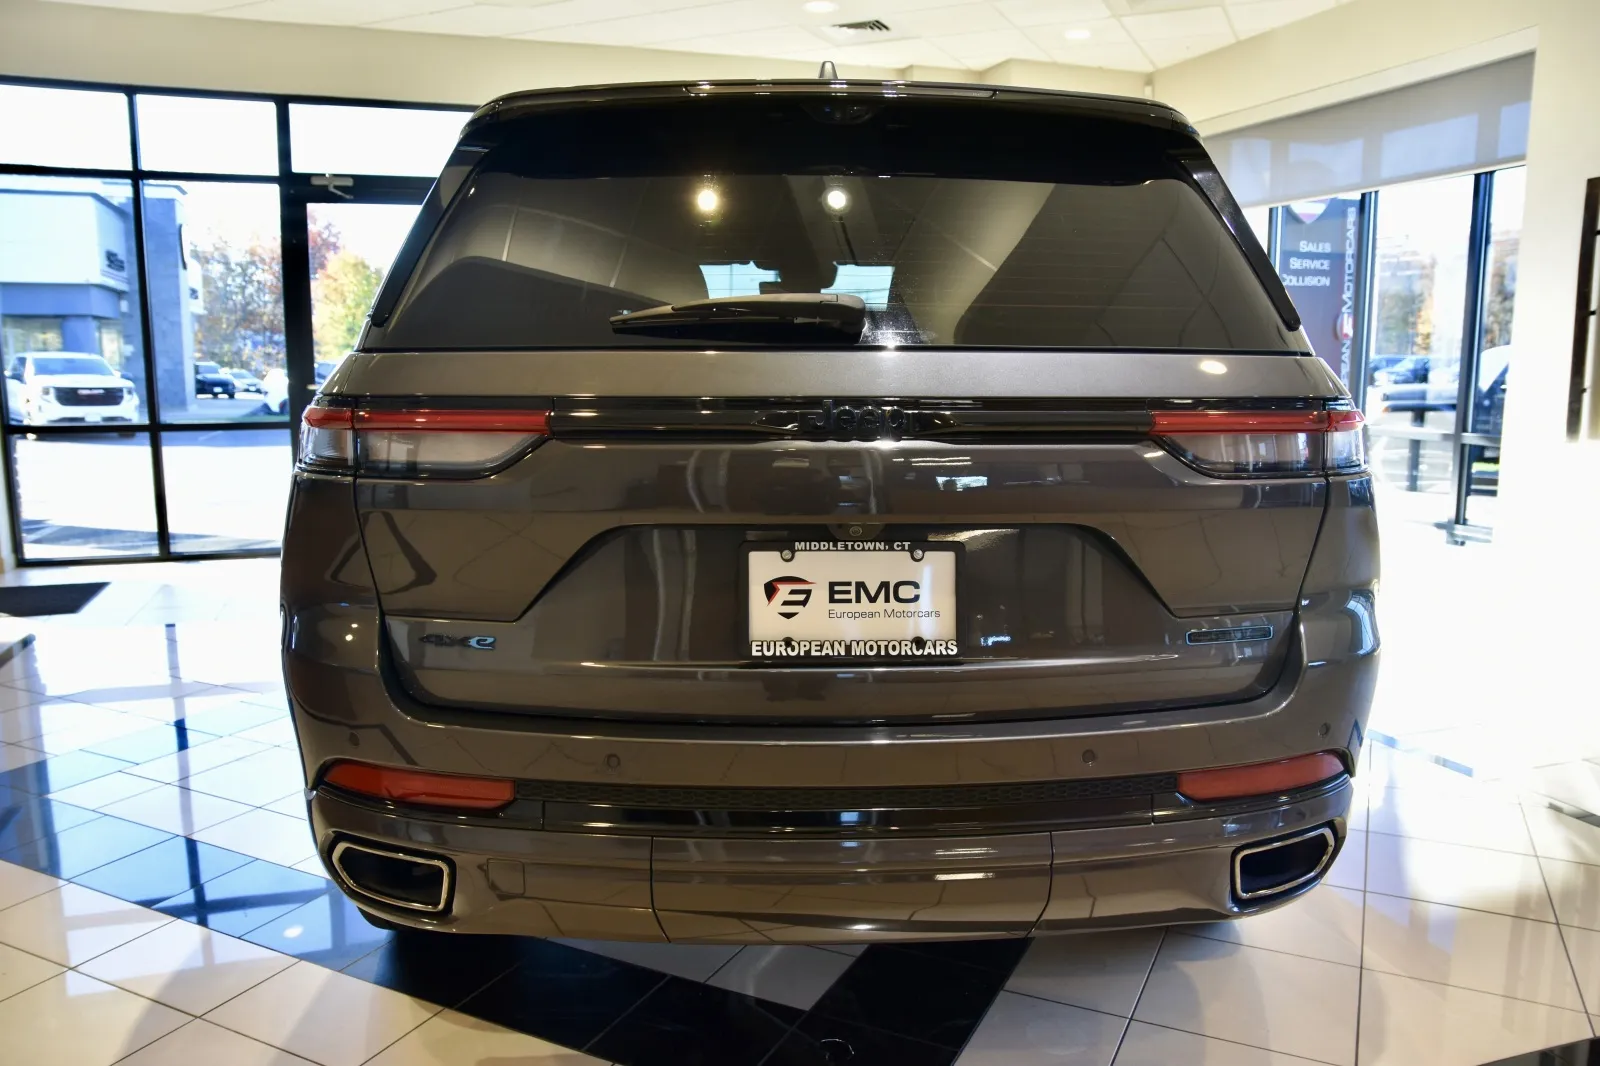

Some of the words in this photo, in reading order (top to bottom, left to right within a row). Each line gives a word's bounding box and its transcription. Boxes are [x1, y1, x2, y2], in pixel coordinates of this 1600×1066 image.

[1299, 240, 1331, 253] SALES
[1289, 257, 1330, 270] SERVICE
[795, 541, 889, 550] MIDDLETOWN,
[893, 541, 911, 550] CT
[828, 581, 920, 604] EMC
[828, 608, 881, 620] European
[883, 608, 941, 618] Motorcars
[751, 641, 846, 656] EUROPEAN
